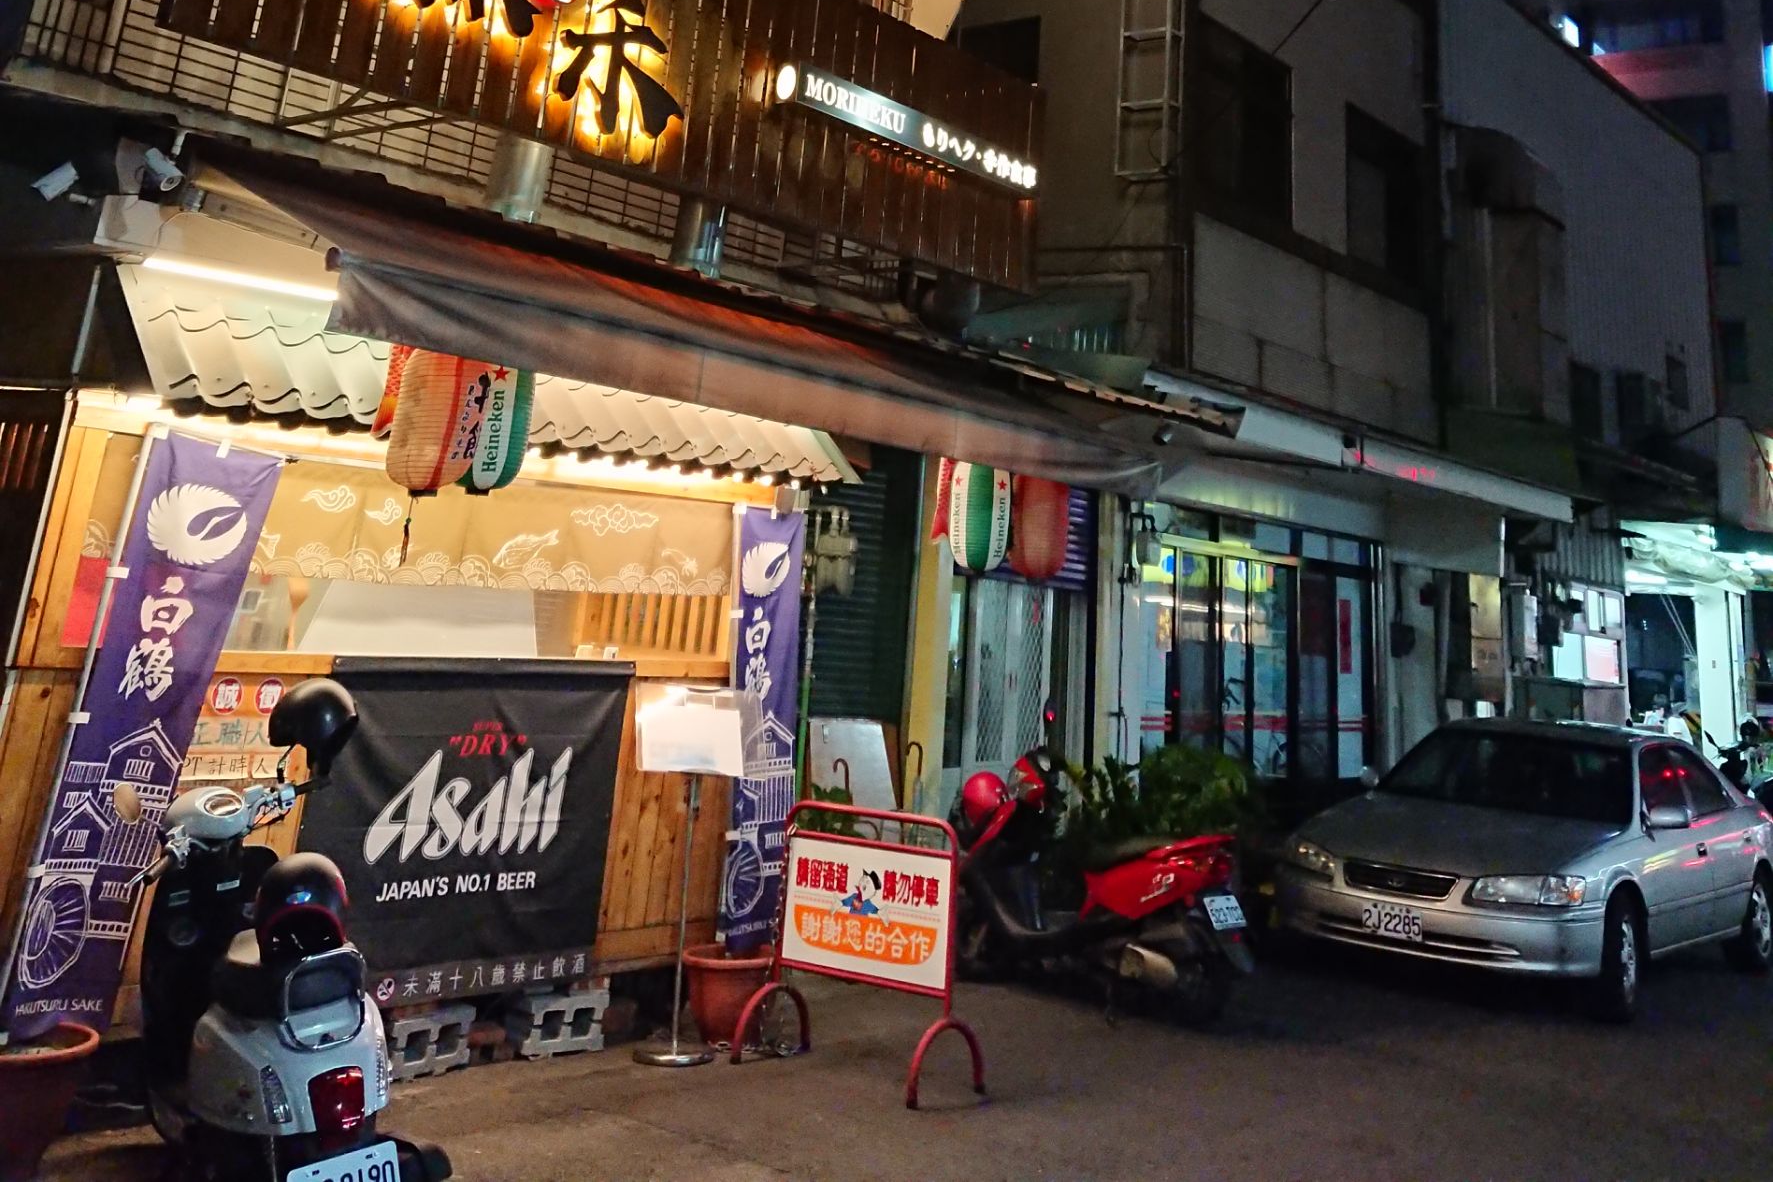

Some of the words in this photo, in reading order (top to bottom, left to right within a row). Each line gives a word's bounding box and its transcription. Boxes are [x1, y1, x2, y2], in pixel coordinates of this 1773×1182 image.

[481, 389, 506, 473] Heineken
[993, 497, 1006, 559] Heineken
[118, 576, 193, 701] 白鶴
[745, 606, 772, 703] 白鶴
[363, 747, 572, 864] Asahi
[375, 875, 449, 903] JAPAN'S
[455, 873, 490, 893] NO.1
[496, 871, 536, 891] BEER
[796, 856, 849, 894] 請留通道
[882, 869, 940, 908] 請勿停車
[800, 912, 931, 961] 謝謝您的合作
[403, 954, 586, 997] 未滿十八歲禁止飲酒
[71, 998, 104, 1012] SAKE
